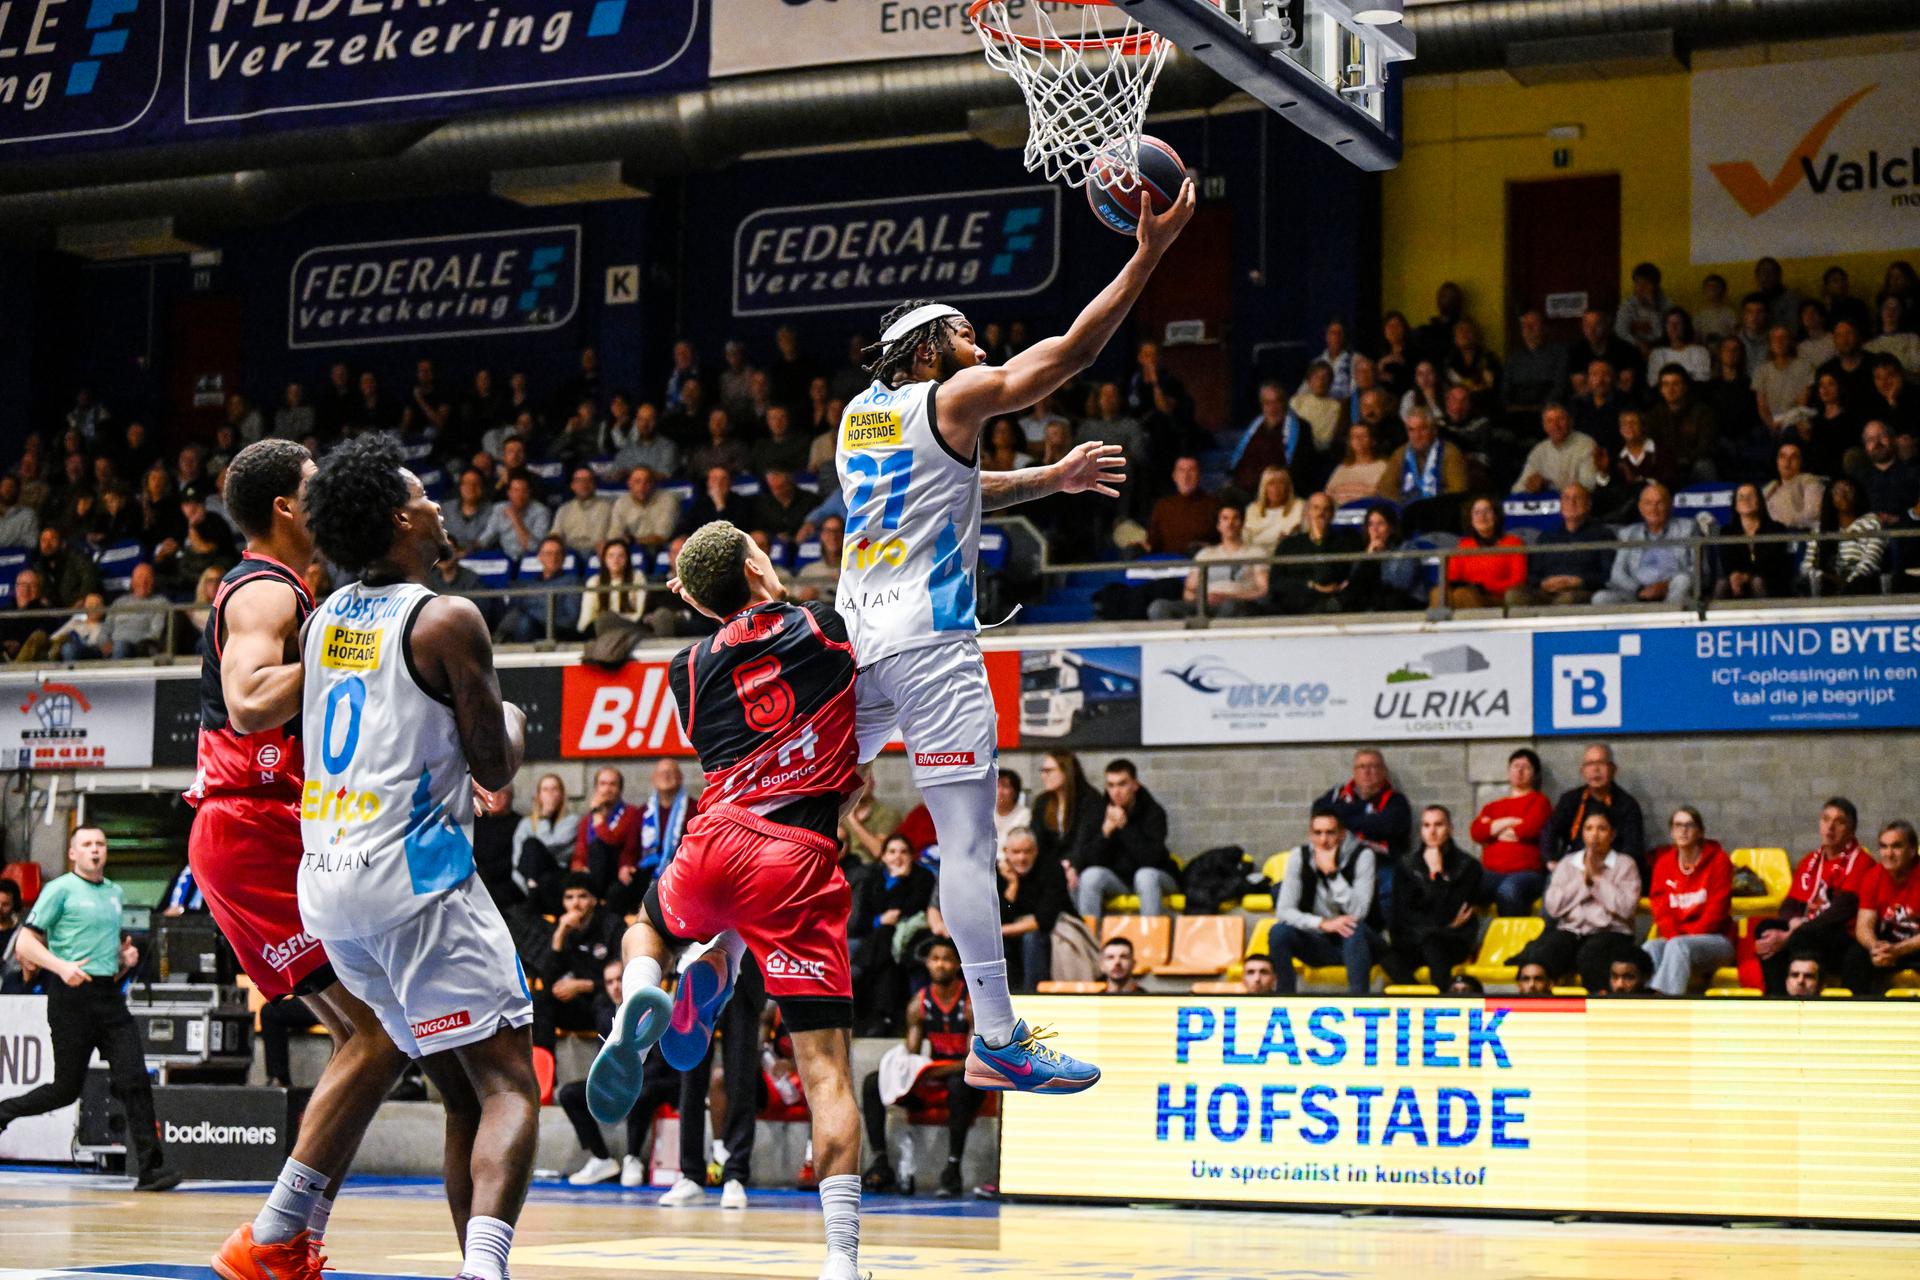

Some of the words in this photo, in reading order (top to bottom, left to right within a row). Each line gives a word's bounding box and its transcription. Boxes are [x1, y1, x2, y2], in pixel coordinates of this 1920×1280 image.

[208, 9, 572, 80] Verzekering
[747, 211, 991, 267] FEDERALE
[303, 250, 519, 300] FEDERALE
[613, 271, 630, 297] K
[745, 257, 980, 295] Verzekering
[300, 294, 508, 330] Verzekering
[847, 424, 896, 441] HOFSTADE
[851, 411, 892, 428] PLASTIEK
[845, 449, 913, 534] 21
[1696, 628, 1821, 658] BEHIND
[1712, 667, 1859, 685] ICT-oplossingen
[1864, 666, 1879, 680] in
[1884, 667, 1917, 681] een
[731, 654, 795, 732] 5
[1374, 689, 1510, 719] ULRIKA
[1733, 688, 1765, 705] taal
[1770, 688, 1797, 704] die
[1802, 687, 1818, 706] je
[1823, 687, 1895, 706] begrijpt
[322, 676, 366, 775] 0
[1405, 720, 1473, 732] LOGISTICS
[761, 764, 817, 788] Banque
[301, 780, 381, 823] Erico
[1176, 1006, 1512, 1068] PLASTIEK
[1156, 1083, 1531, 1149] HOFSTADE
[165, 1121, 276, 1145] badkamers
[1191, 1160, 1224, 1181] Uw
[1231, 1162, 1340, 1184] specialist
[1348, 1165, 1367, 1182] in
[1375, 1165, 1487, 1186] kunststof
